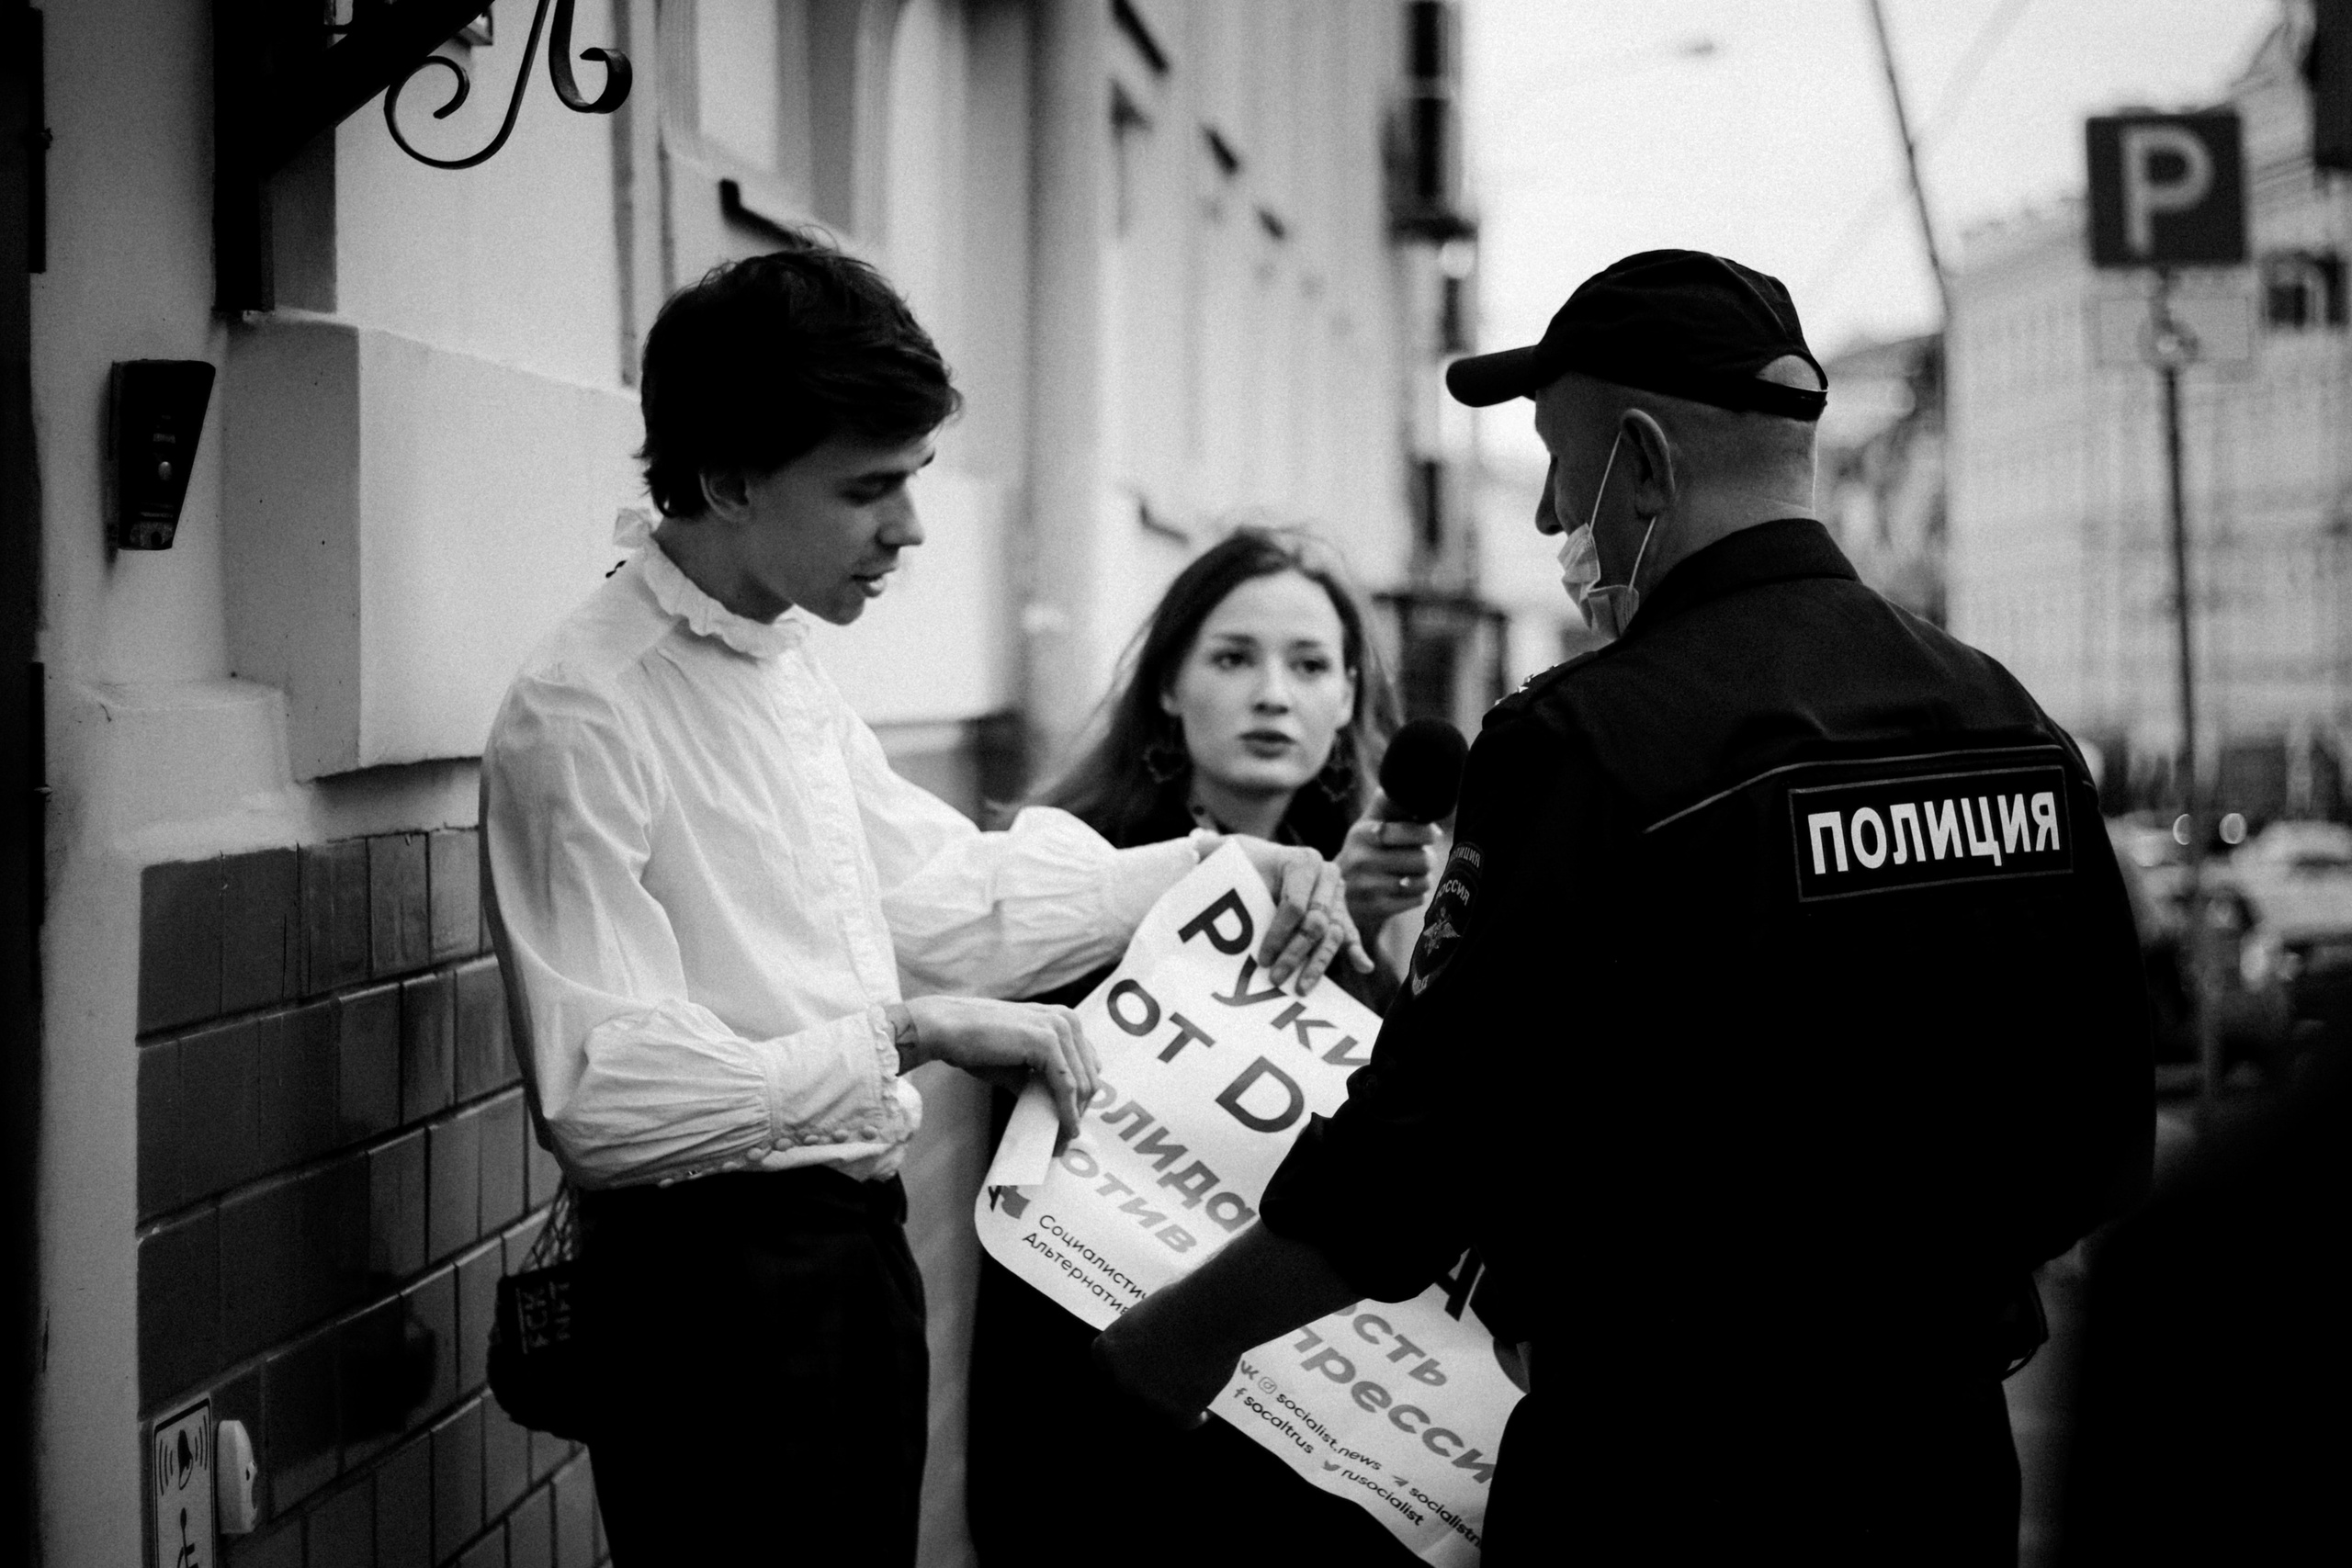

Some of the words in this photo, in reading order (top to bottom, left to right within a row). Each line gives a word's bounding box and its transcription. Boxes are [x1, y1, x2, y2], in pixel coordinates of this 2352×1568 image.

[2119, 126, 2211, 254] P
[1808, 792, 2061, 874] ПОЛИЦИЯ
[1058, 1148, 1197, 1254] отив
[1023, 1232, 1129, 1315] Альтернатив
[1243, 1395, 1314, 1454] socaltrus
[1340, 1470, 1425, 1527] rusocialist
[1408, 1486, 1481, 1548] socialistn
